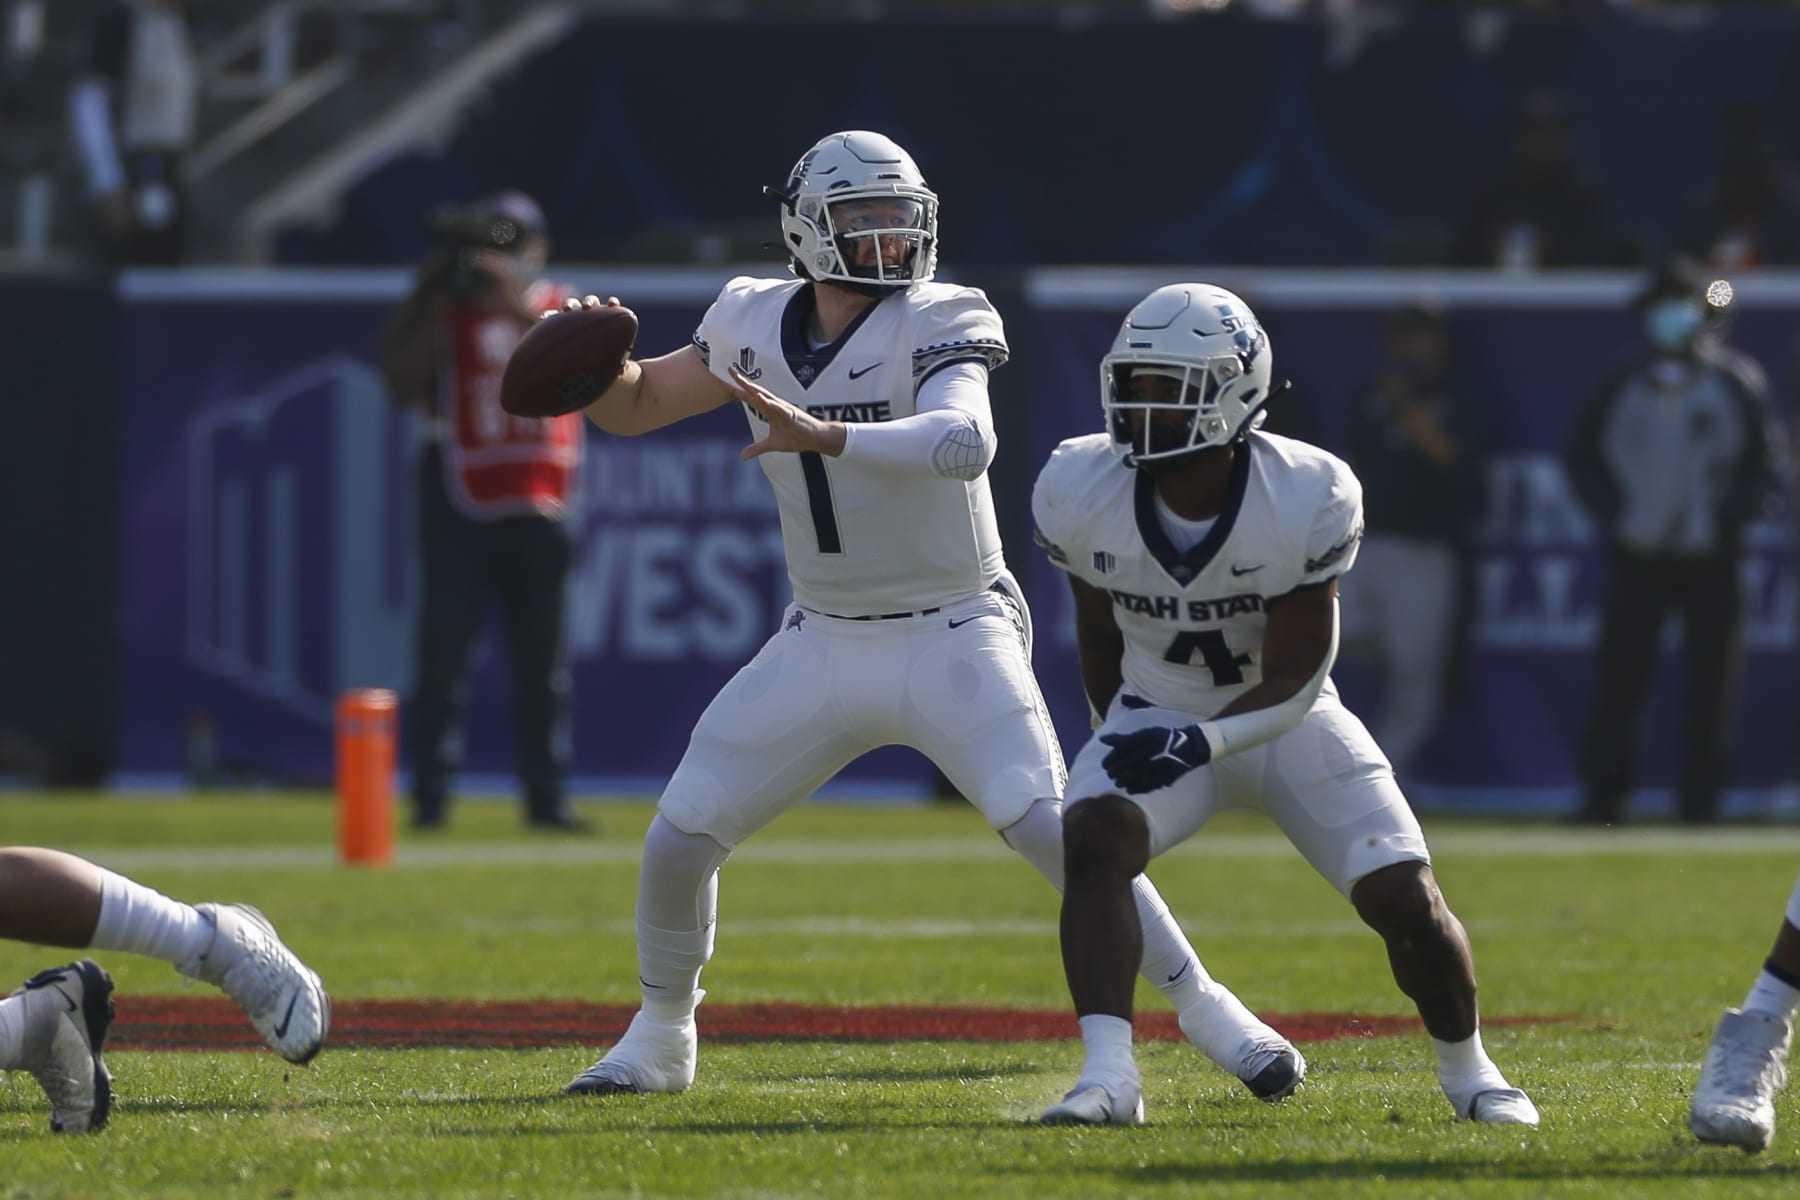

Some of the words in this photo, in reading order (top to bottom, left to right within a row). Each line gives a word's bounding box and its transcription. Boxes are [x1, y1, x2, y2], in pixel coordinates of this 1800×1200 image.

[806, 400, 892, 422] STATE
[799, 451, 842, 554] 1
[1188, 593, 1265, 622] STAT
[1164, 628, 1253, 687] 4
